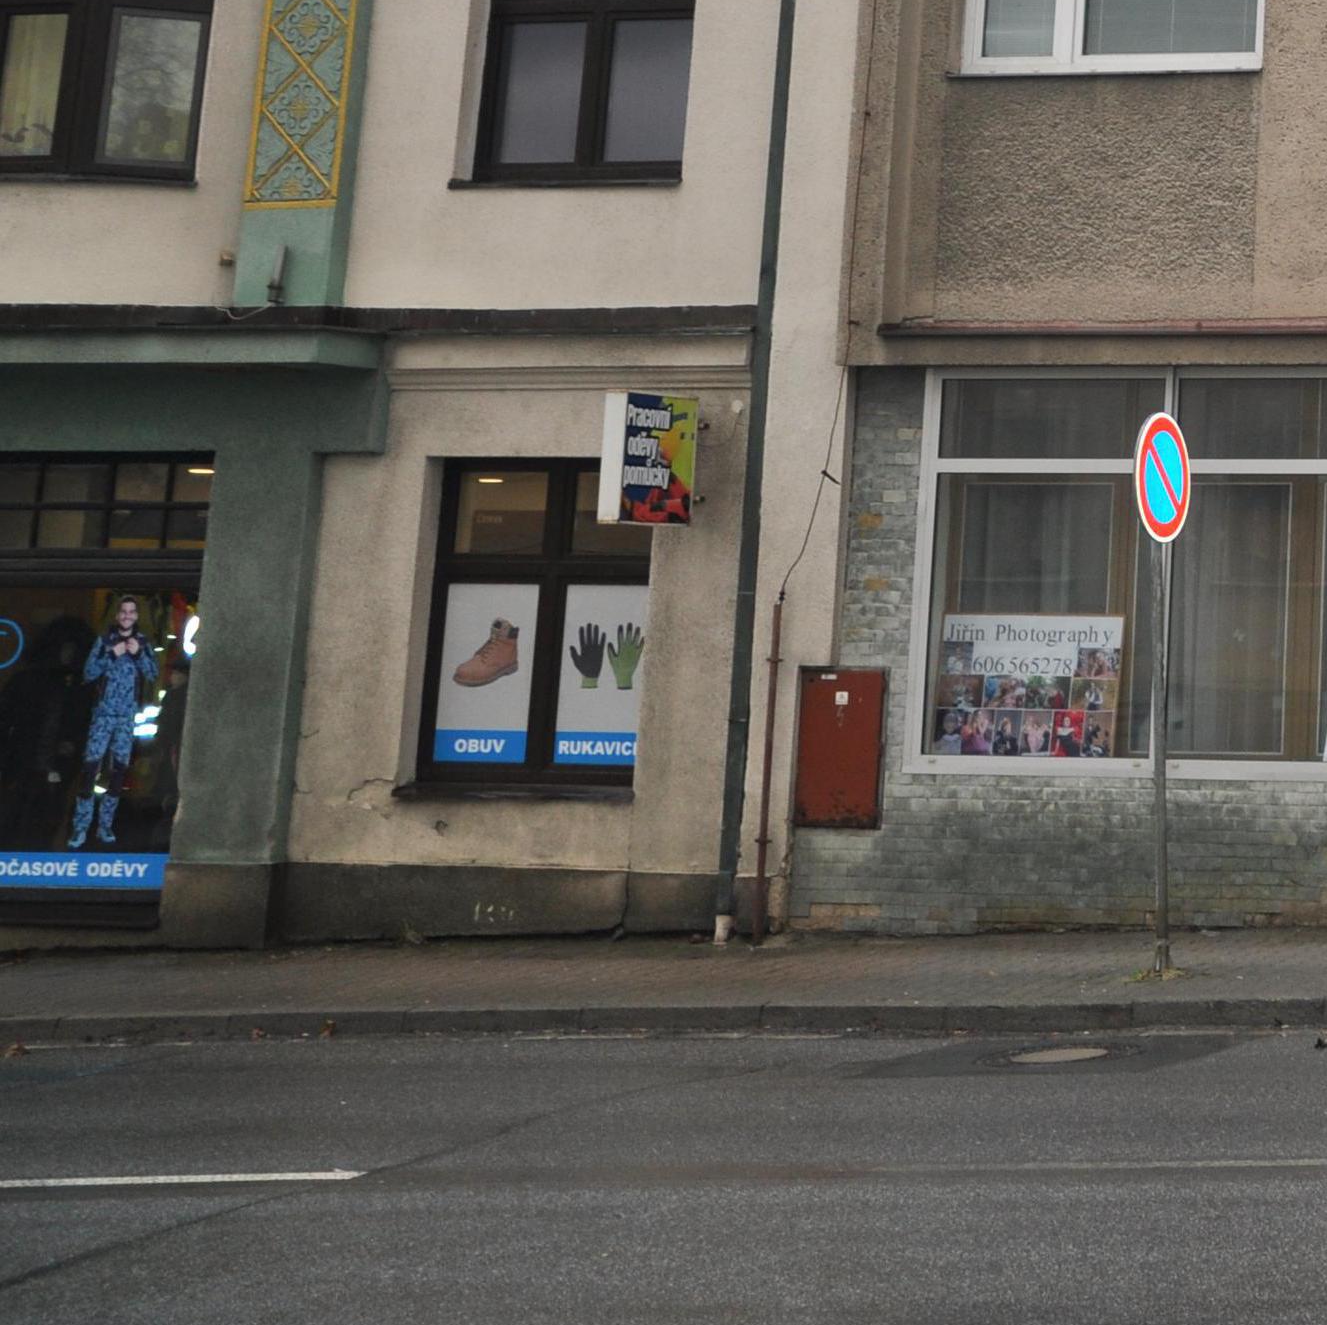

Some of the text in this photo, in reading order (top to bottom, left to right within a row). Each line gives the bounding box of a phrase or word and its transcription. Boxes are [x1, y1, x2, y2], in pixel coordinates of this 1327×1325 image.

[626, 404, 672, 430] Pracovní
[627, 431, 659, 460] oděvy
[623, 458, 670, 491] pomůcky
[995, 623, 1114, 647] Photography
[454, 738, 506, 753] OBUV
[86, 859, 149, 878] ODĚVY
